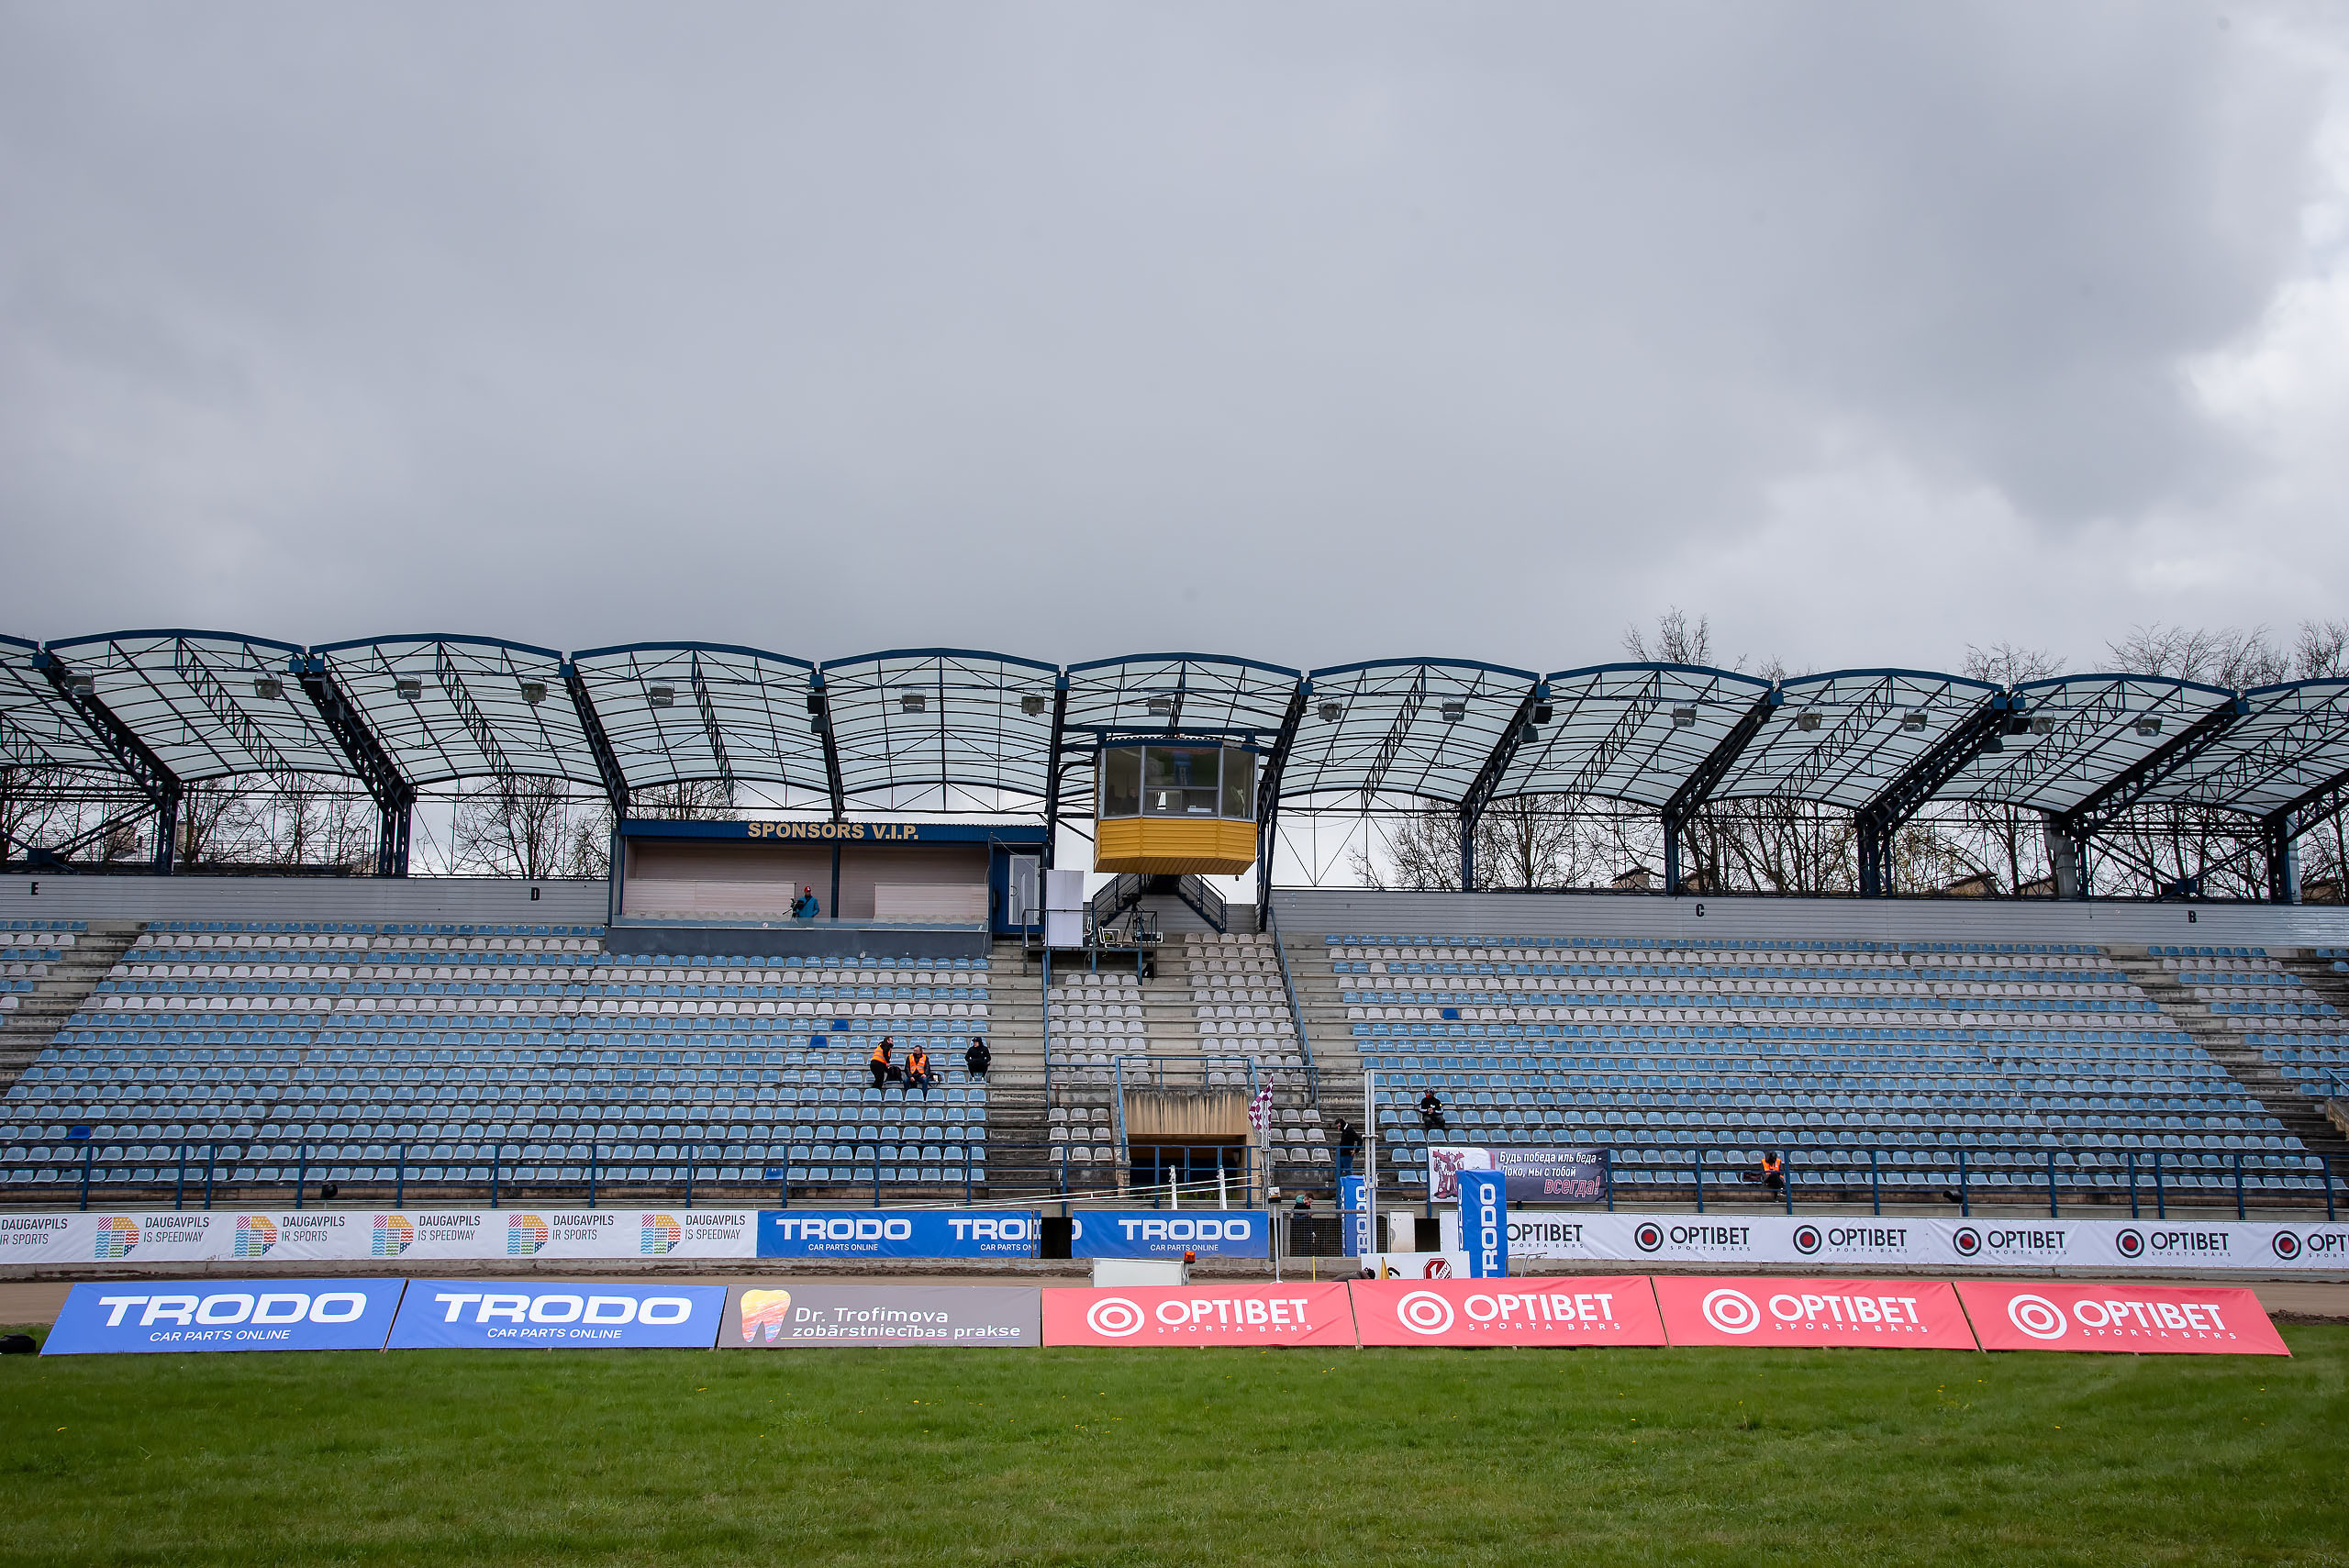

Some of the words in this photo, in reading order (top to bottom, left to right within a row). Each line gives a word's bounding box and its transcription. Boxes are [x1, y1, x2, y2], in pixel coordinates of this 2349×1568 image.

[748, 823, 864, 839] SPONSORS
[872, 825, 919, 840] V.I.P.
[30, 882, 39, 895] E
[530, 887, 540, 901] D
[1696, 904, 1705, 917] C
[2188, 910, 2198, 923] B
[1499, 1151, 1521, 1164] Будь
[1523, 1151, 1555, 1163] победа
[1557, 1153, 1575, 1163] иль
[1575, 1152, 1597, 1164] беда
[1528, 1167, 1542, 1177] мы
[1543, 1168, 1550, 1177] с
[1552, 1165, 1576, 1177] тобой
[1543, 1176, 1601, 1197] всегда!
[2, 1218, 68, 1230] DAUGAVPILS
[146, 1217, 210, 1229] DAUGAVPILS
[283, 1216, 345, 1228] DAUGAVPILS
[419, 1216, 481, 1227] DAUGAVPILS
[553, 1215, 615, 1226] DAUGAVPILS
[685, 1215, 746, 1226] DAUGAVPILS
[281, 1231, 291, 1242] IR
[294, 1230, 328, 1242] SPORTS
[418, 1230, 427, 1241] IS
[429, 1229, 475, 1241] SPEEDWAY
[552, 1229, 562, 1240] IR
[564, 1229, 597, 1240] SPORTS
[685, 1229, 694, 1240] IS
[696, 1229, 741, 1240] SPEEDWAY
[776, 1219, 912, 1240] TRODO
[1119, 1219, 1251, 1240] TRODO
[1507, 1223, 1584, 1241] OPTIBET
[1670, 1226, 1749, 1245] OPTIBET
[12, 1233, 49, 1245] SPORTS
[144, 1232, 152, 1243] IS
[155, 1231, 204, 1242] SPEEDWAY
[1829, 1229, 1907, 1246] OPTIBET
[1987, 1230, 2065, 1249] OPTIBET
[2151, 1232, 2229, 1251] OPTIBET
[2308, 1234, 2349, 1252] OPT
[808, 1243, 824, 1251] CAR
[825, 1243, 850, 1251] PARTS
[851, 1243, 878, 1251] ONLINE
[981, 1243, 996, 1251] CAR
[997, 1243, 1021, 1251] PARTS
[1150, 1243, 1165, 1251] CAR
[1166, 1243, 1190, 1251] PARTS
[1192, 1243, 1219, 1251] ONLINE
[99, 1293, 366, 1327] TRODO
[435, 1294, 693, 1324] TRODO
[1156, 1299, 1308, 1324] OPTIBET
[1464, 1294, 1612, 1321] OPTIBET
[1769, 1295, 1919, 1324] OPTIBET
[795, 1307, 826, 1323] Dr.
[834, 1307, 949, 1323] Trofimova
[2074, 1299, 2225, 1330] OPTIBET
[792, 1324, 948, 1338] zobārstniecības
[954, 1325, 1021, 1340] prakse
[1158, 1325, 1244, 1333] SPORTA
[1469, 1322, 1553, 1330] SPORTA
[1776, 1322, 1860, 1332] SPORTA
[150, 1331, 181, 1341] CAR
[184, 1330, 233, 1340] PARTS
[236, 1329, 291, 1340] ONLINE
[487, 1328, 517, 1338] CAR
[520, 1328, 566, 1338] PARTS
[569, 1328, 622, 1339] ONLINE
[2083, 1329, 2168, 1338] SPORTA
